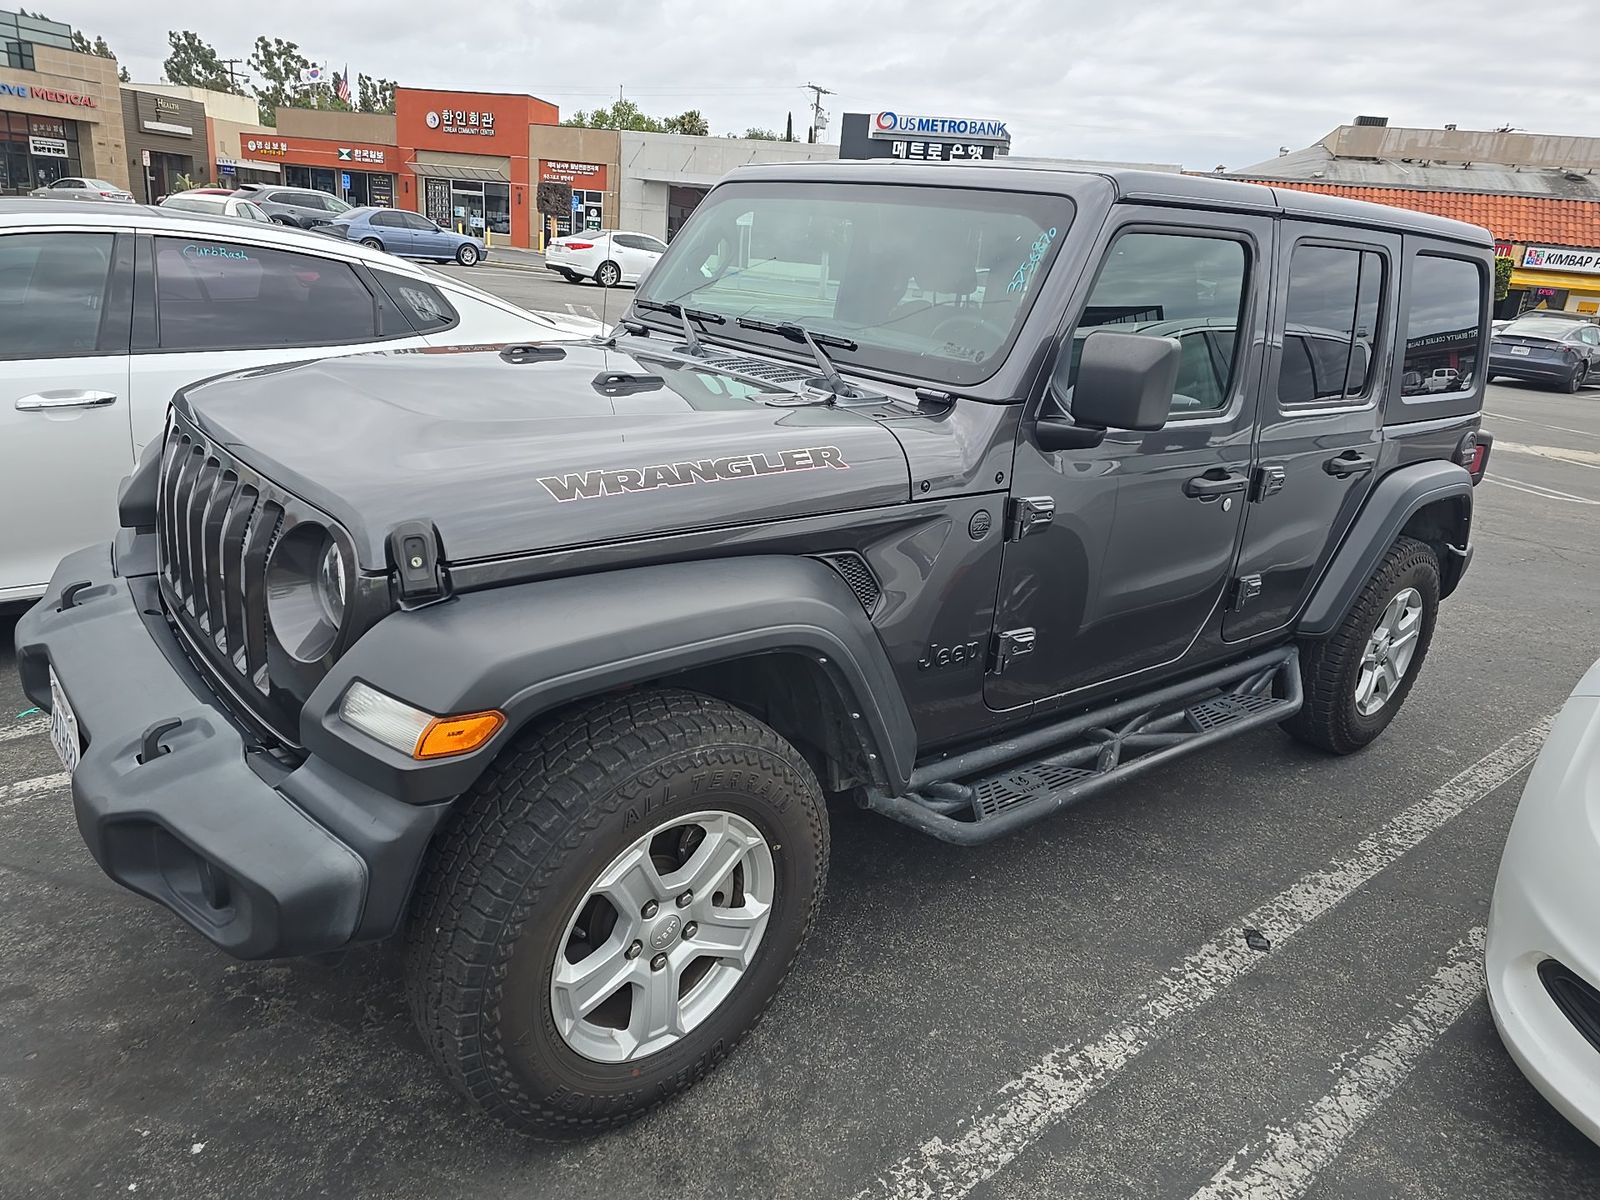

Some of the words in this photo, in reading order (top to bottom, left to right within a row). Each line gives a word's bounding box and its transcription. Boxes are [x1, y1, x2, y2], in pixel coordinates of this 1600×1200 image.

[31, 86, 97, 108] MEDICAL
[442, 109, 494, 128] 한인회관
[900, 117, 916, 131] US
[917, 118, 968, 133] METRO
[968, 121, 1007, 136] BANK
[458, 127, 480, 135] COMMUNITY
[354, 149, 384, 159] 한국일보
[892, 141, 943, 160] 메트로
[1545, 253, 1593, 268] KIMBAP
[536, 446, 851, 502] WRANGLER
[918, 641, 979, 669] Jeep
[623, 785, 677, 831] ALL
[691, 769, 794, 814] TERRAIN
